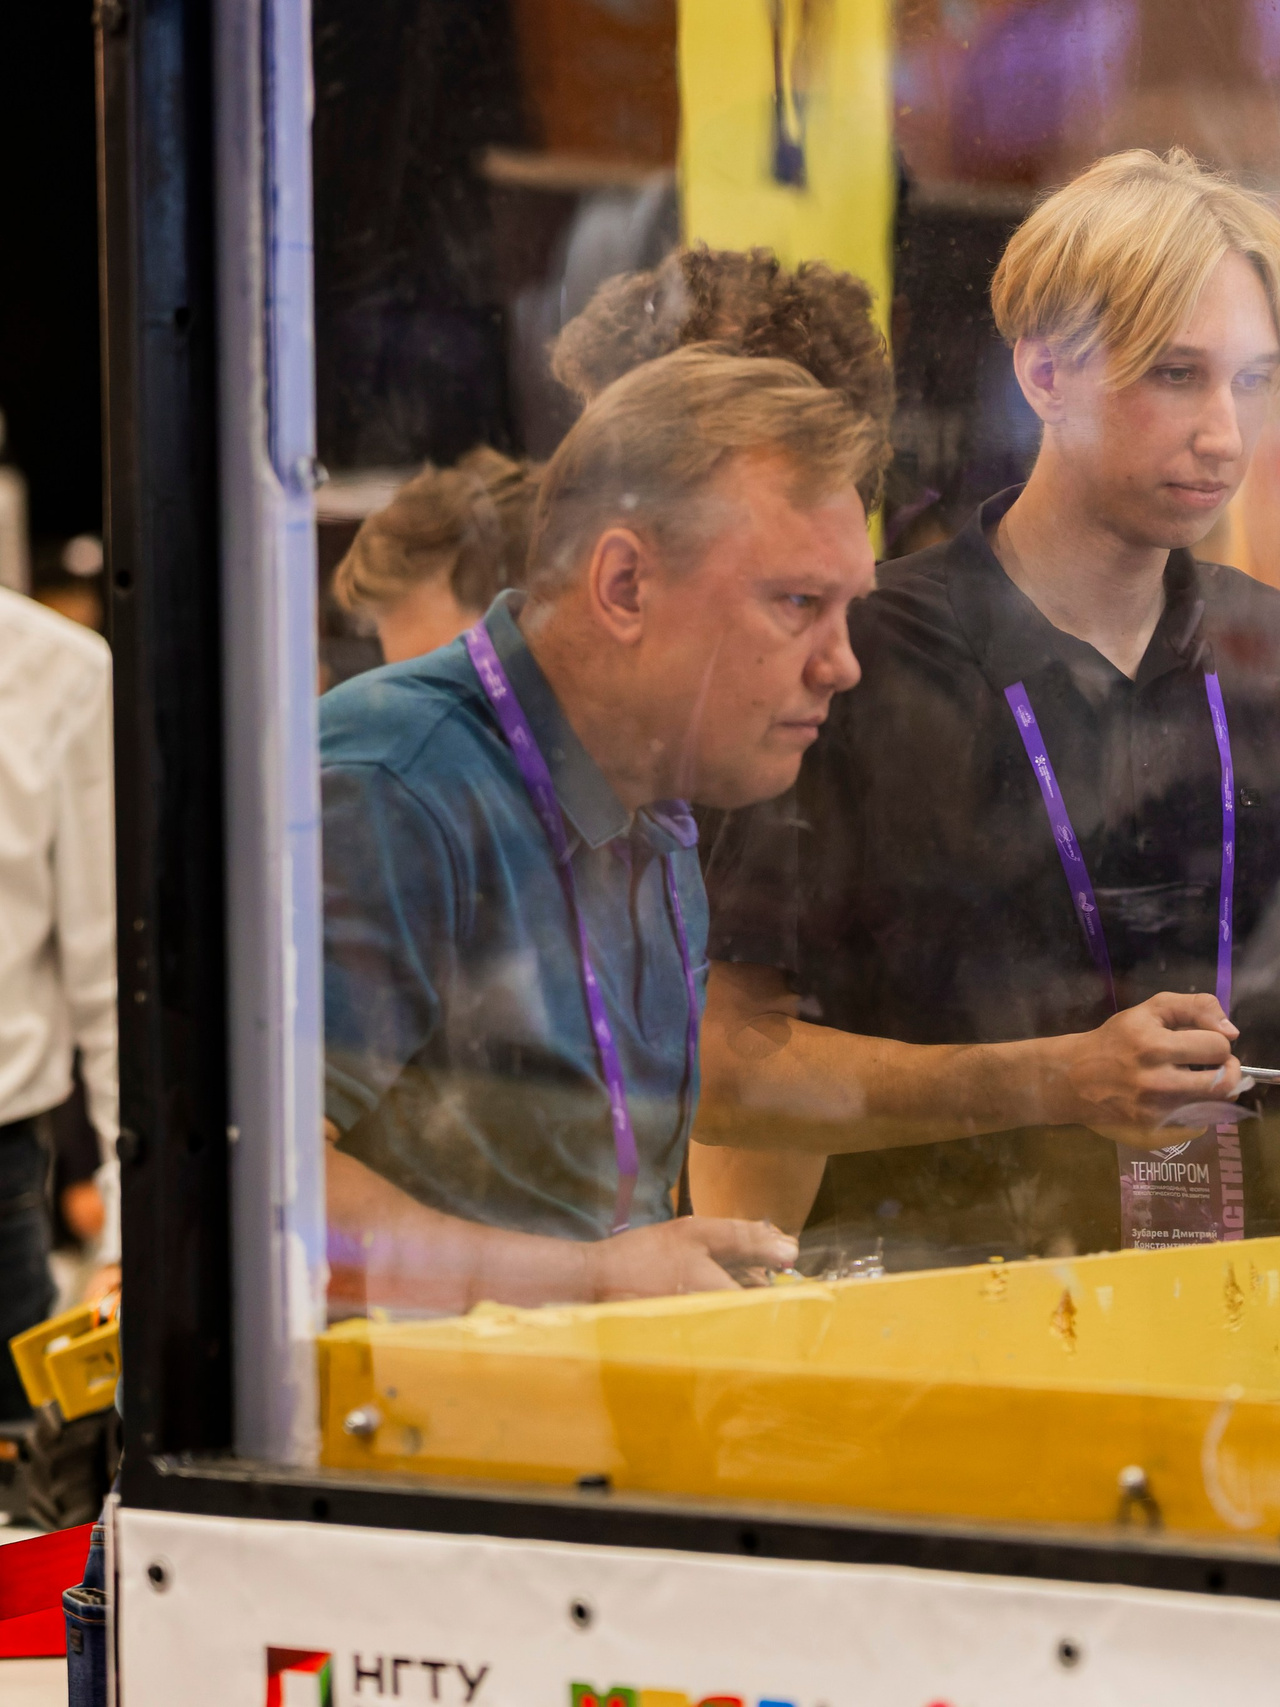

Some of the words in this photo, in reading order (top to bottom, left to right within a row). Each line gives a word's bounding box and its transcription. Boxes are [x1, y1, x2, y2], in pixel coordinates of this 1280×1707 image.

[1131, 1161, 1210, 1184] ТЕХНОПРОМ
[1131, 1228, 1169, 1239] Зубарев
[1172, 1228, 1218, 1240] Дмитрий
[354, 1654, 489, 1702] НГТУ
